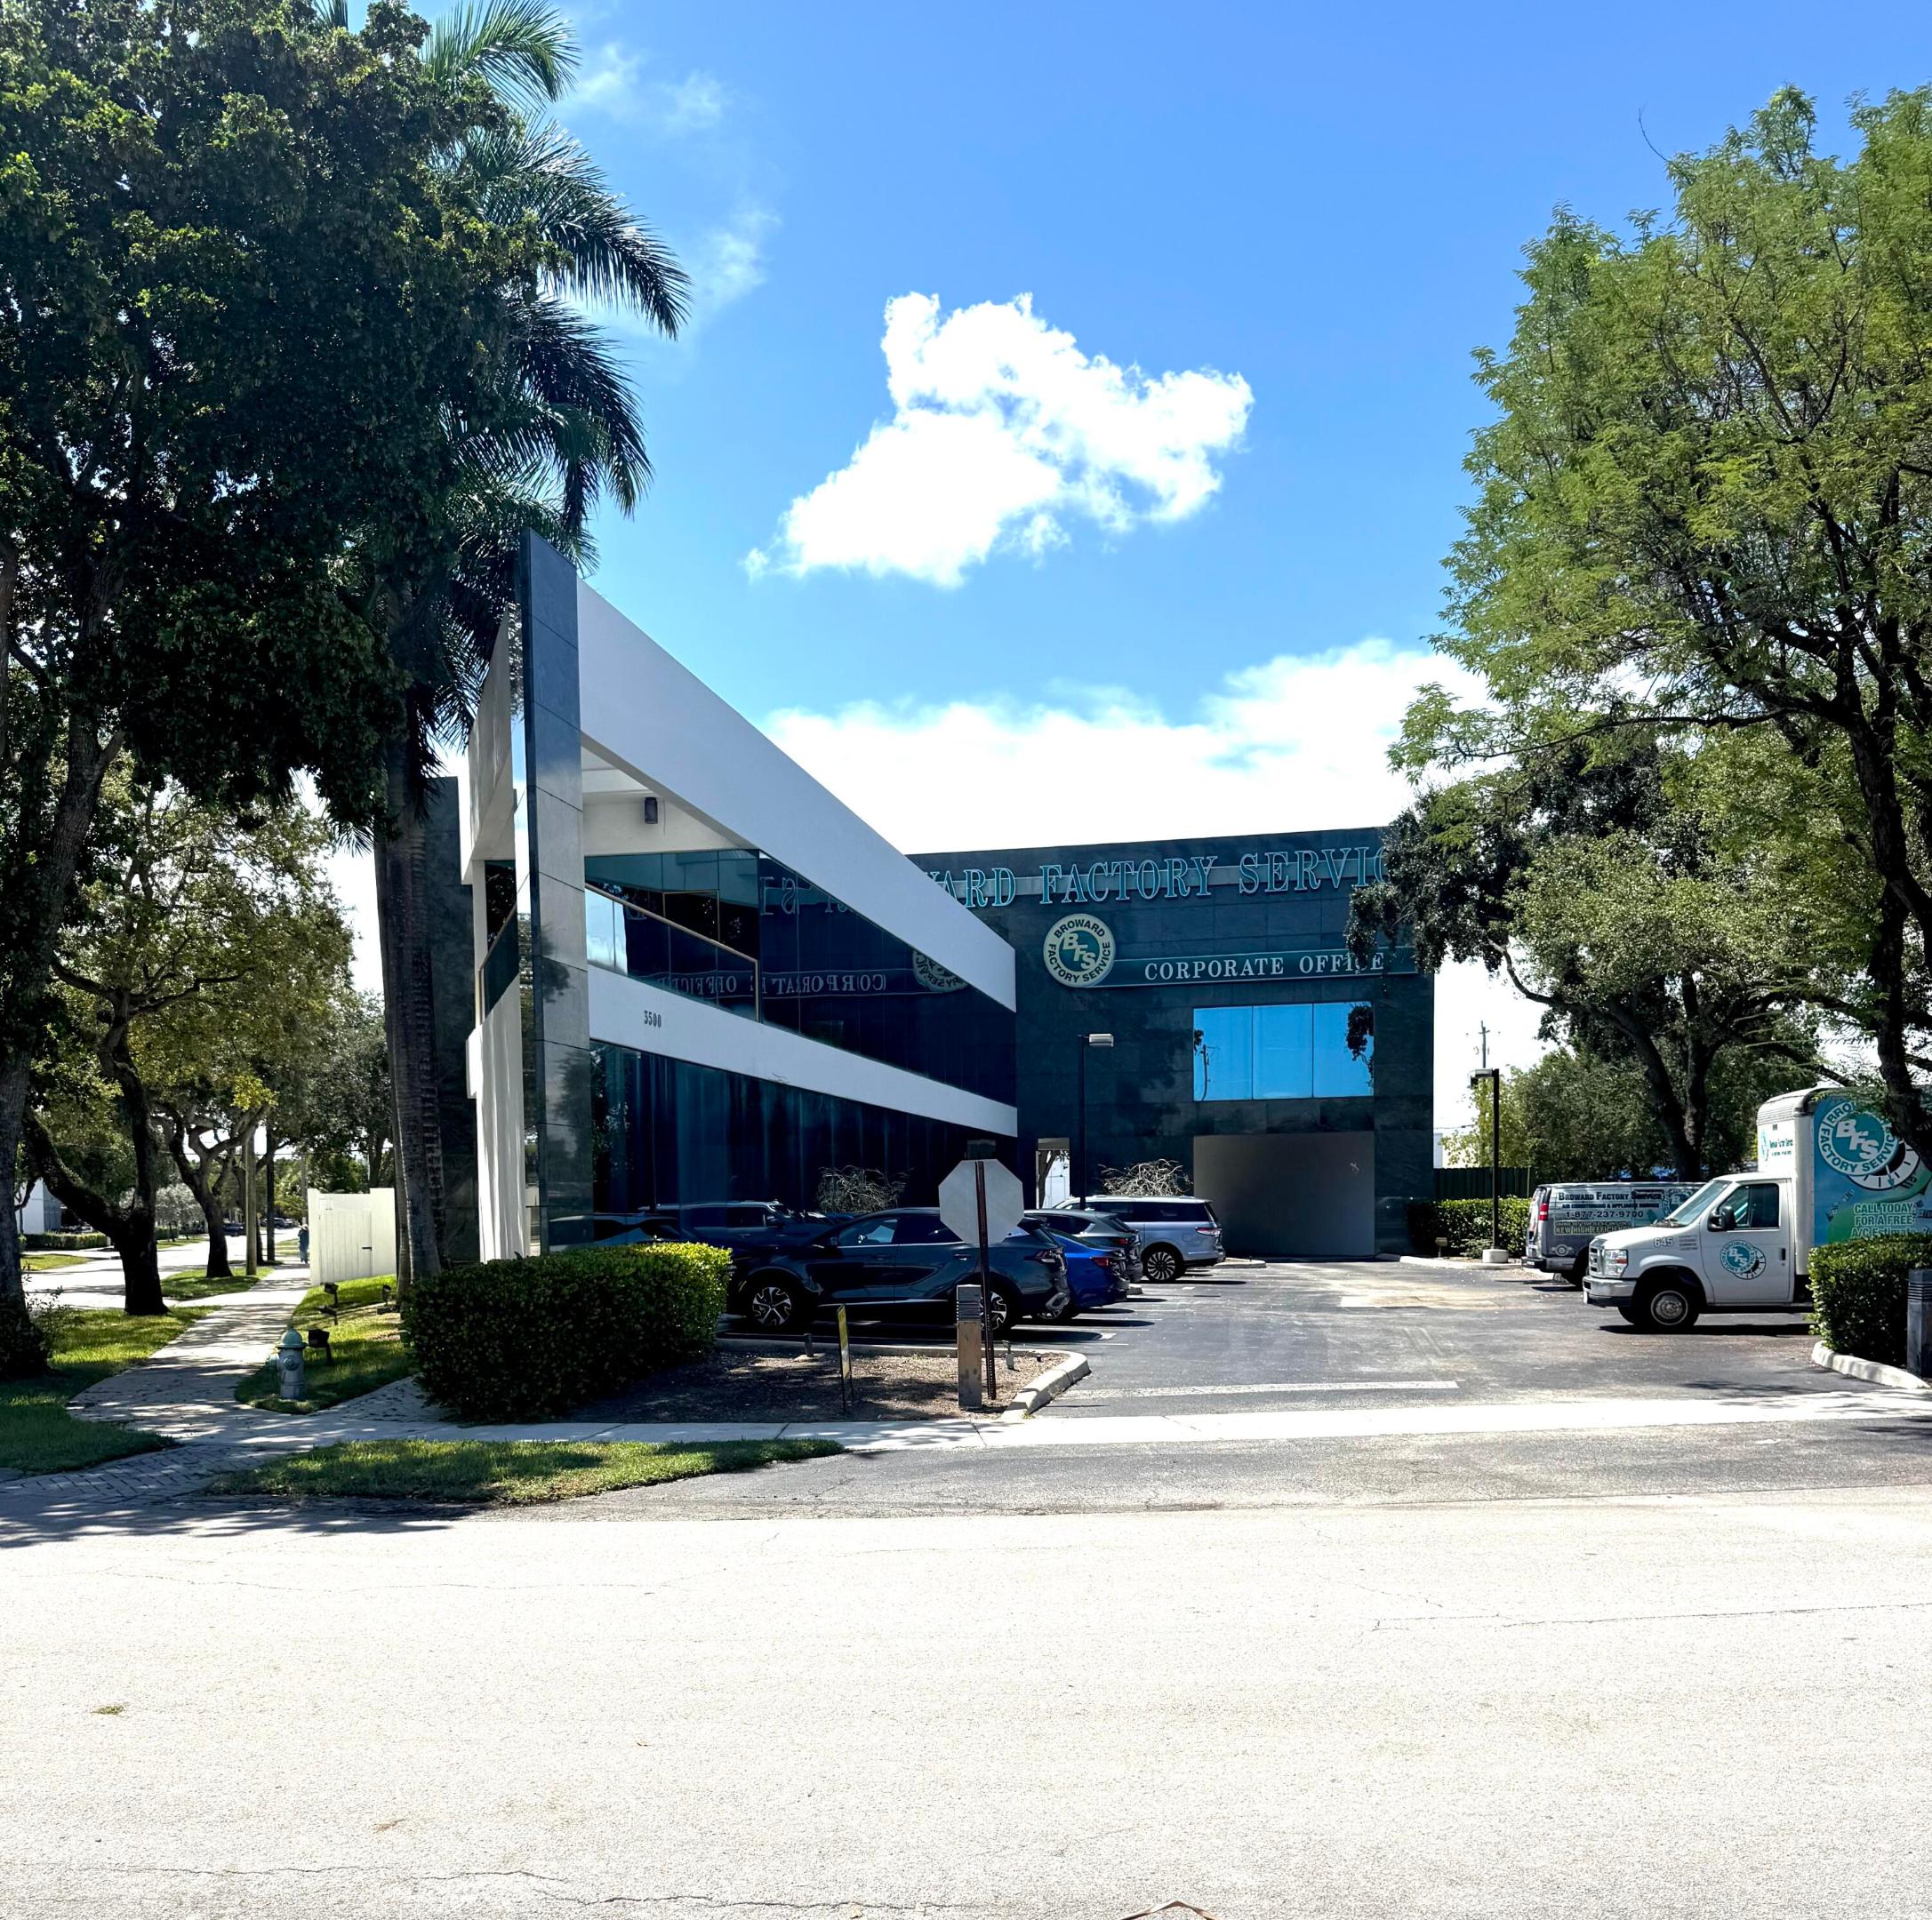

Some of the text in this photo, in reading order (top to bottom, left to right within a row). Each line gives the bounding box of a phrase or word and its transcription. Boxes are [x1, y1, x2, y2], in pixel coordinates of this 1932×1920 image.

[1039, 856, 1219, 905] FACTORY
[1054, 918, 1105, 939] BROWARD
[1062, 932, 1096, 970] BFS
[1048, 941, 1110, 983] FACTORY SERVICE
[1144, 956, 1284, 980] CORPORATE
[644, 1010, 661, 1028] 3500
[1821, 1128, 1896, 1172] FACTORY SERVIC
[1836, 1119, 1879, 1160] BFS
[1559, 1193, 1594, 1201] BROWARD
[1596, 1191, 1629, 1200] FACTORY
[1854, 1203, 1880, 1214] CALL
[1556, 1226, 1573, 1234] NEW
[1855, 1215, 1913, 1226] FOR A FREE
[1655, 1236, 1674, 1248] 645
